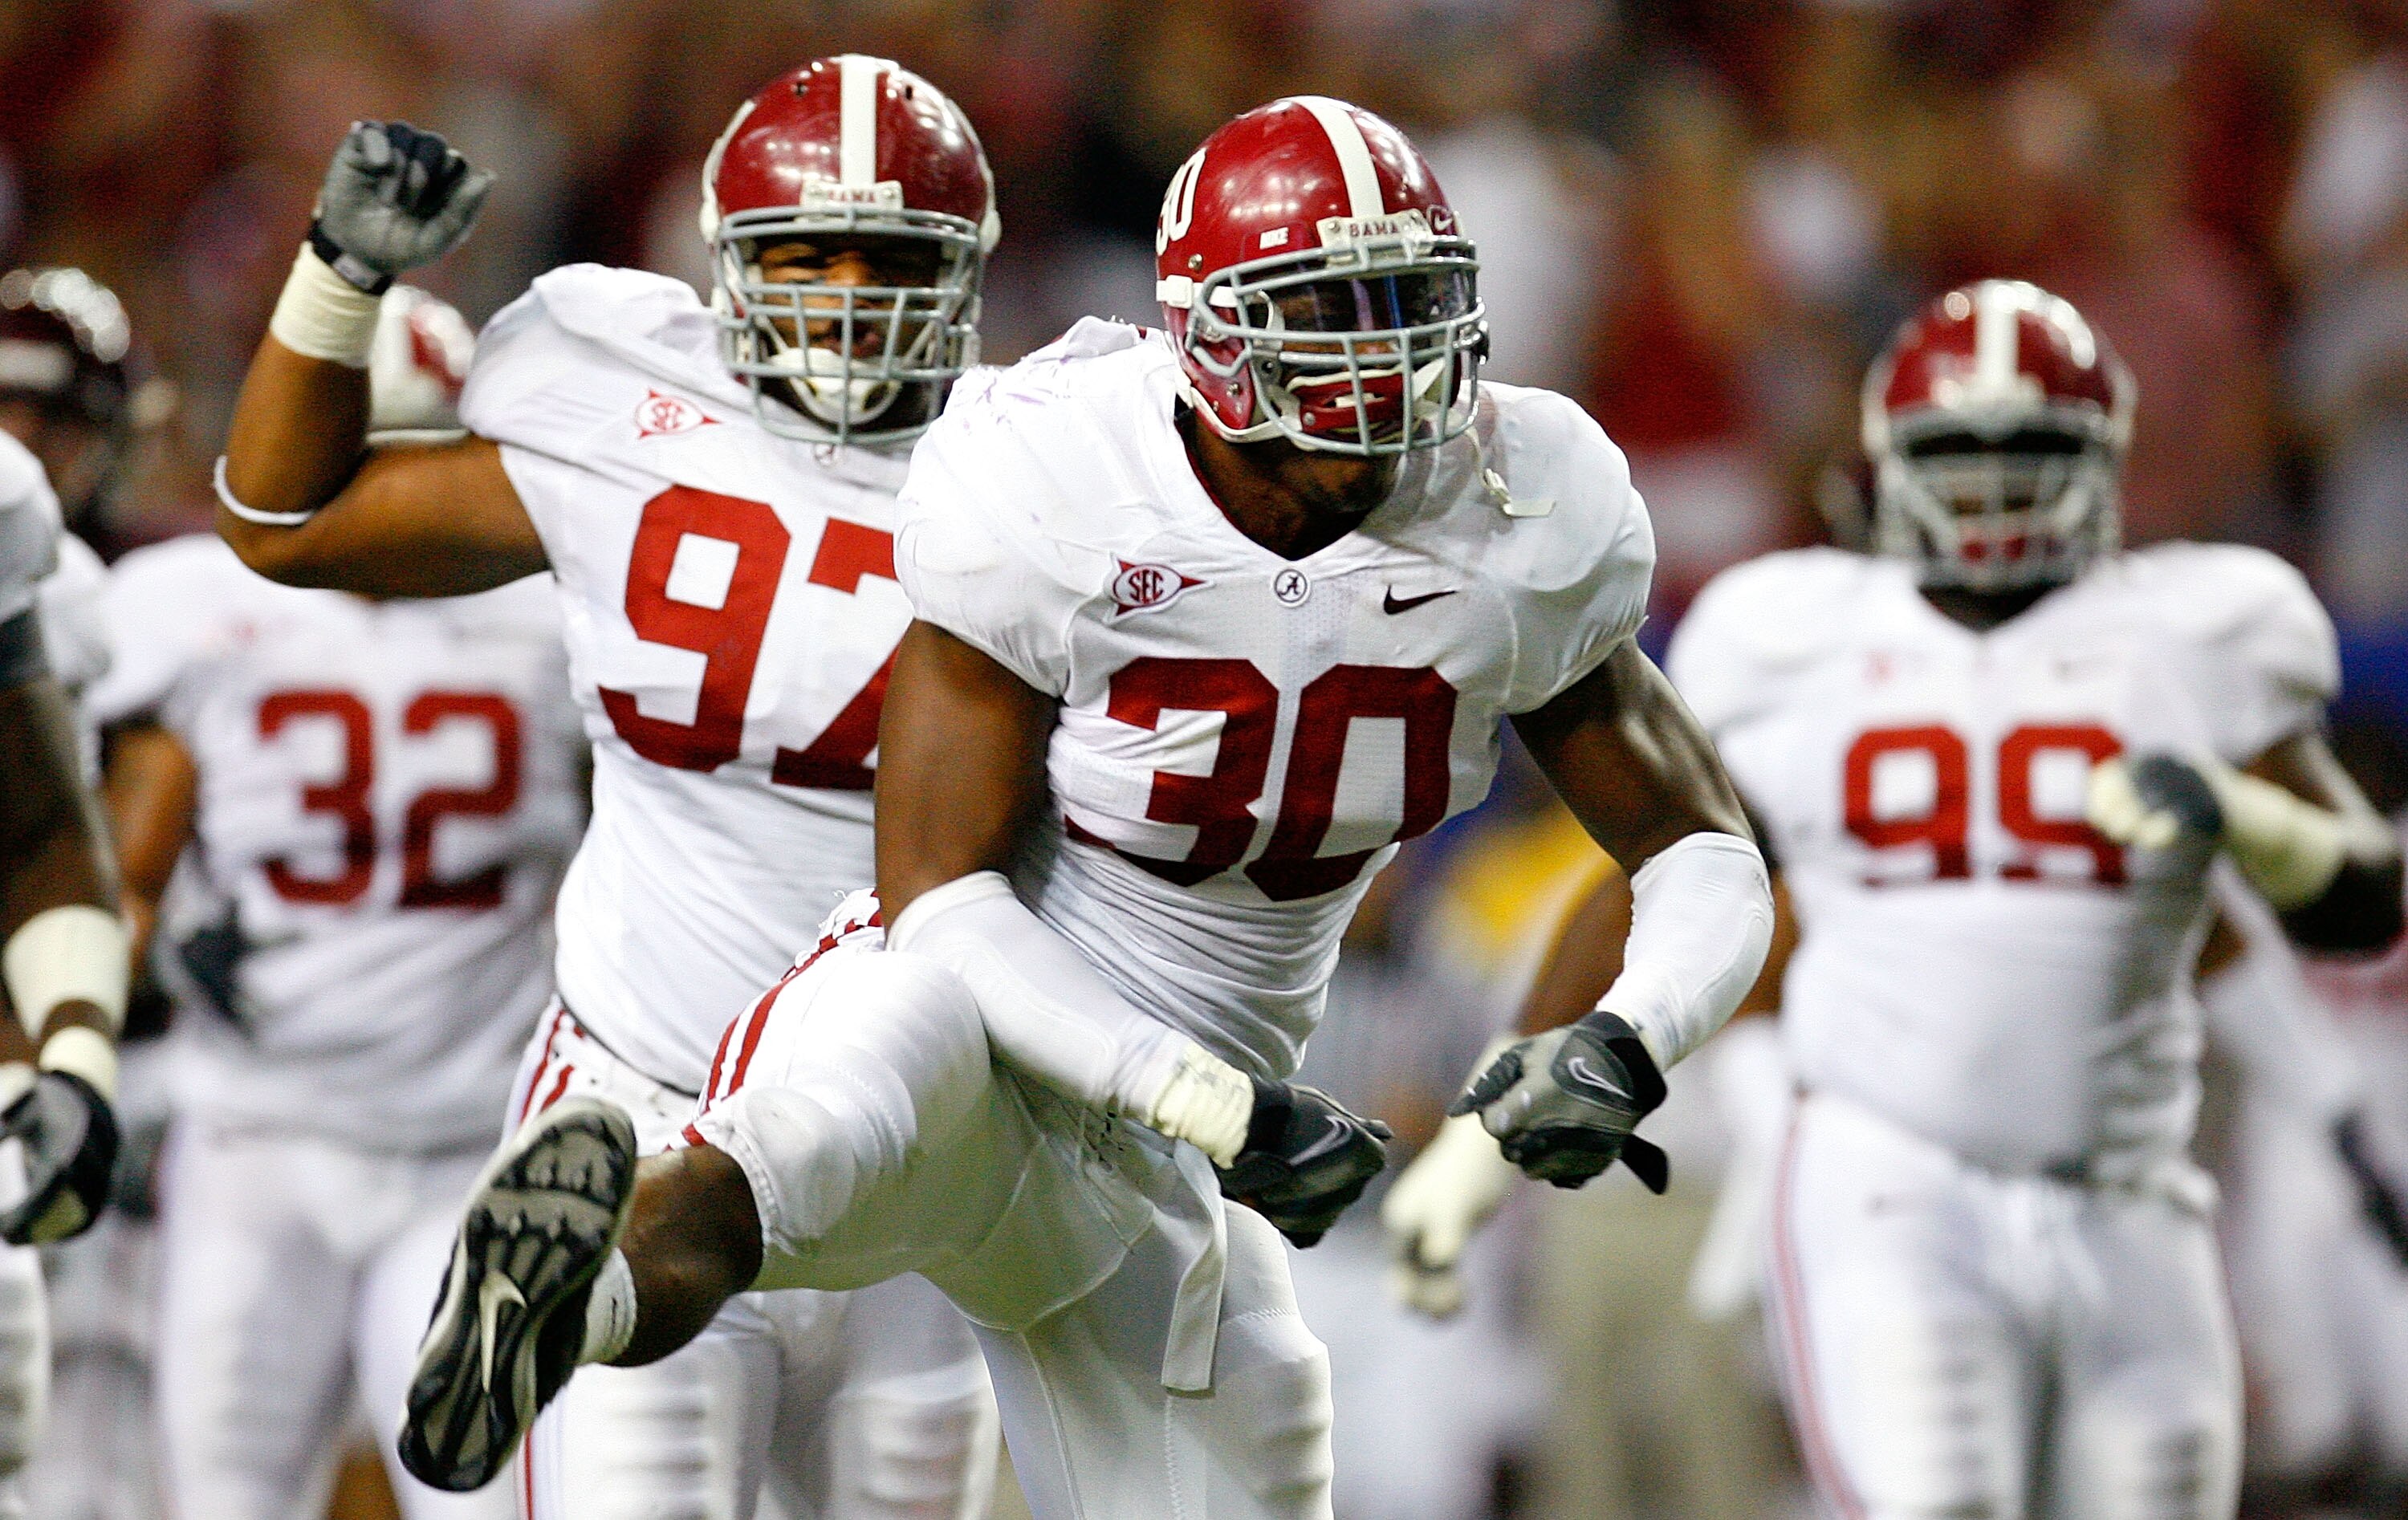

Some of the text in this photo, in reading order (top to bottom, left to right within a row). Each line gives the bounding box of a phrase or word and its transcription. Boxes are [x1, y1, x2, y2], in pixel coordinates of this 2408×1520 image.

[1348, 221, 1398, 238] BAMA
[597, 483, 901, 790] 97
[1128, 568, 1164, 604] SEC
[257, 687, 522, 910] 32
[1064, 656, 1458, 902] 30
[1842, 724, 2125, 890] 99
